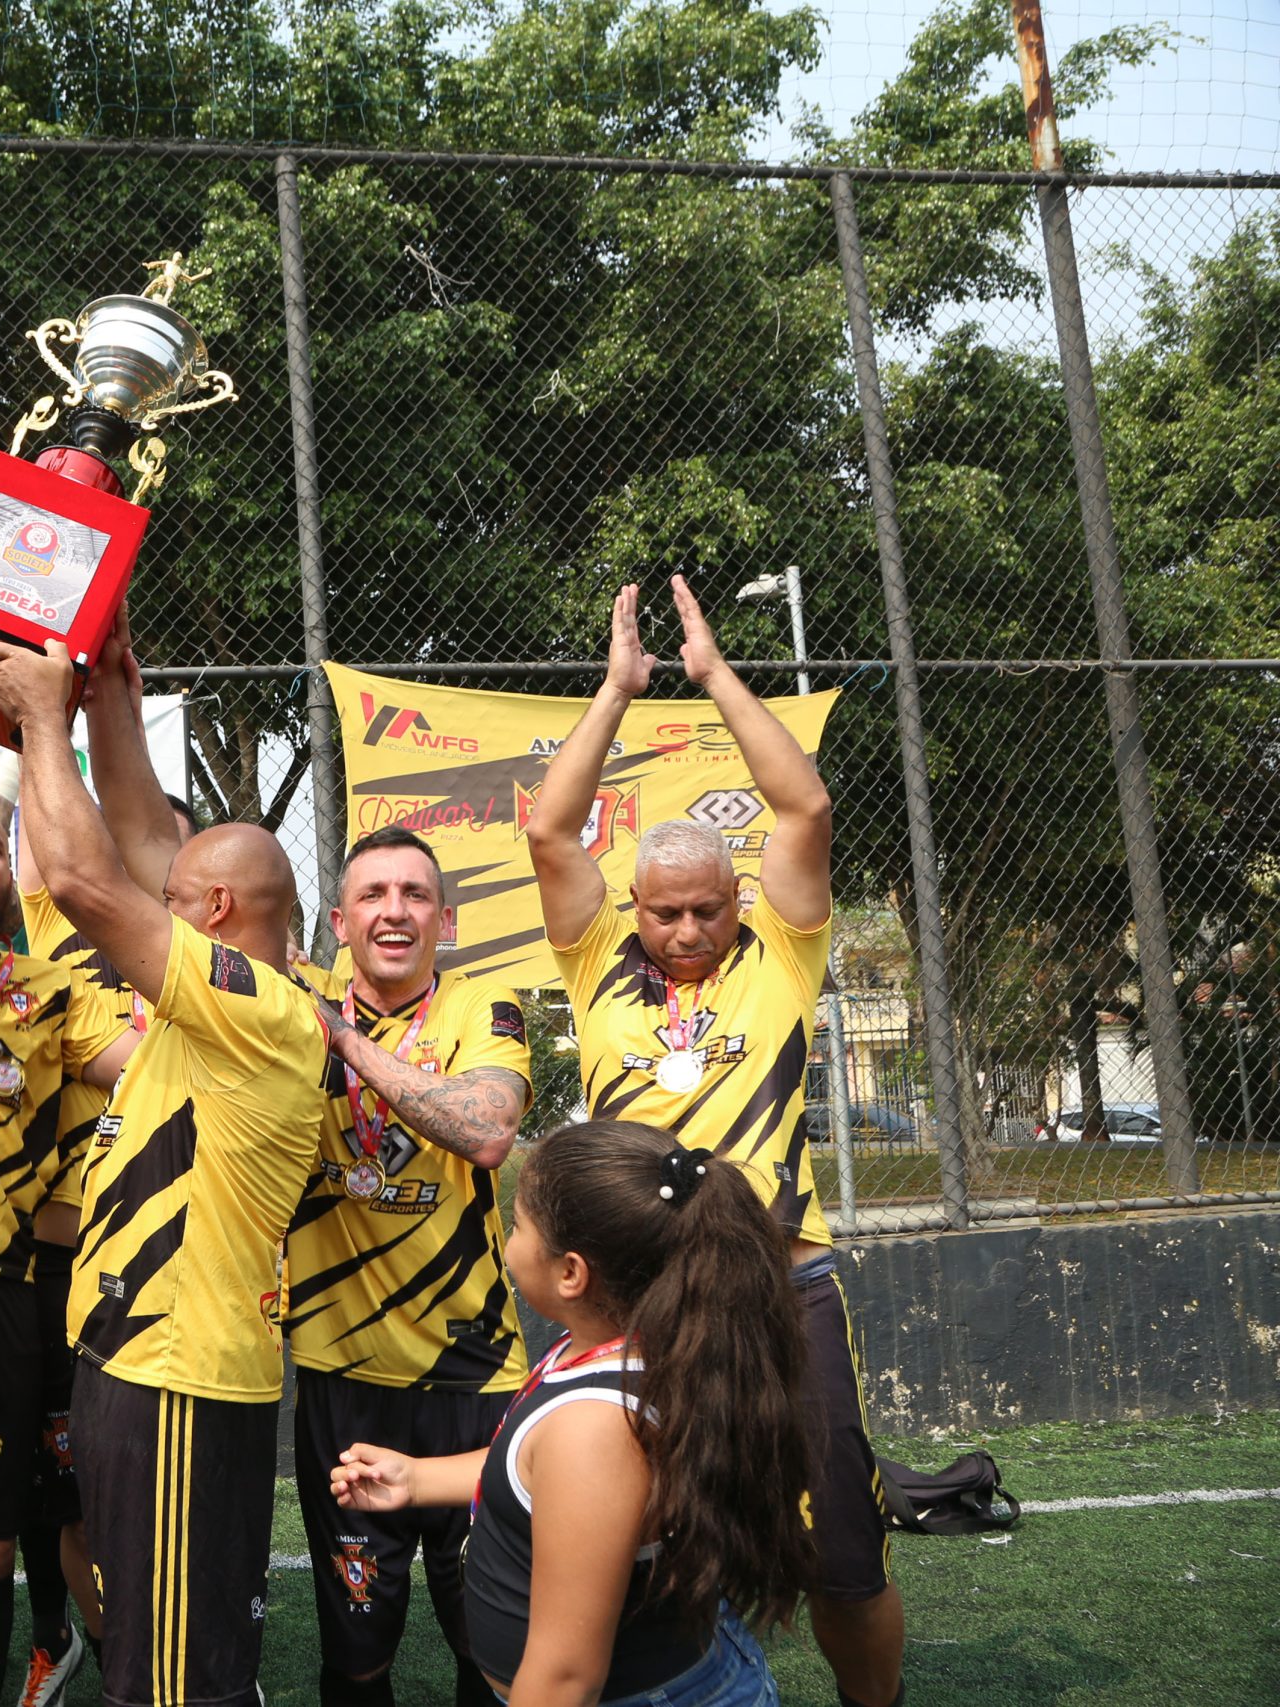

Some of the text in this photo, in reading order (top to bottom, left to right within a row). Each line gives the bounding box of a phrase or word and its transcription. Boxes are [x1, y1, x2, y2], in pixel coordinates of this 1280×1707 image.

[7, 550, 49, 571] SOCIETY
[411, 731, 479, 753] WFG
[531, 738, 624, 756] AMS
[663, 753, 740, 764] MULTIMAR
[370, 1202, 437, 1214] ESPORTES
[335, 1535, 369, 1544] AMIGOS
